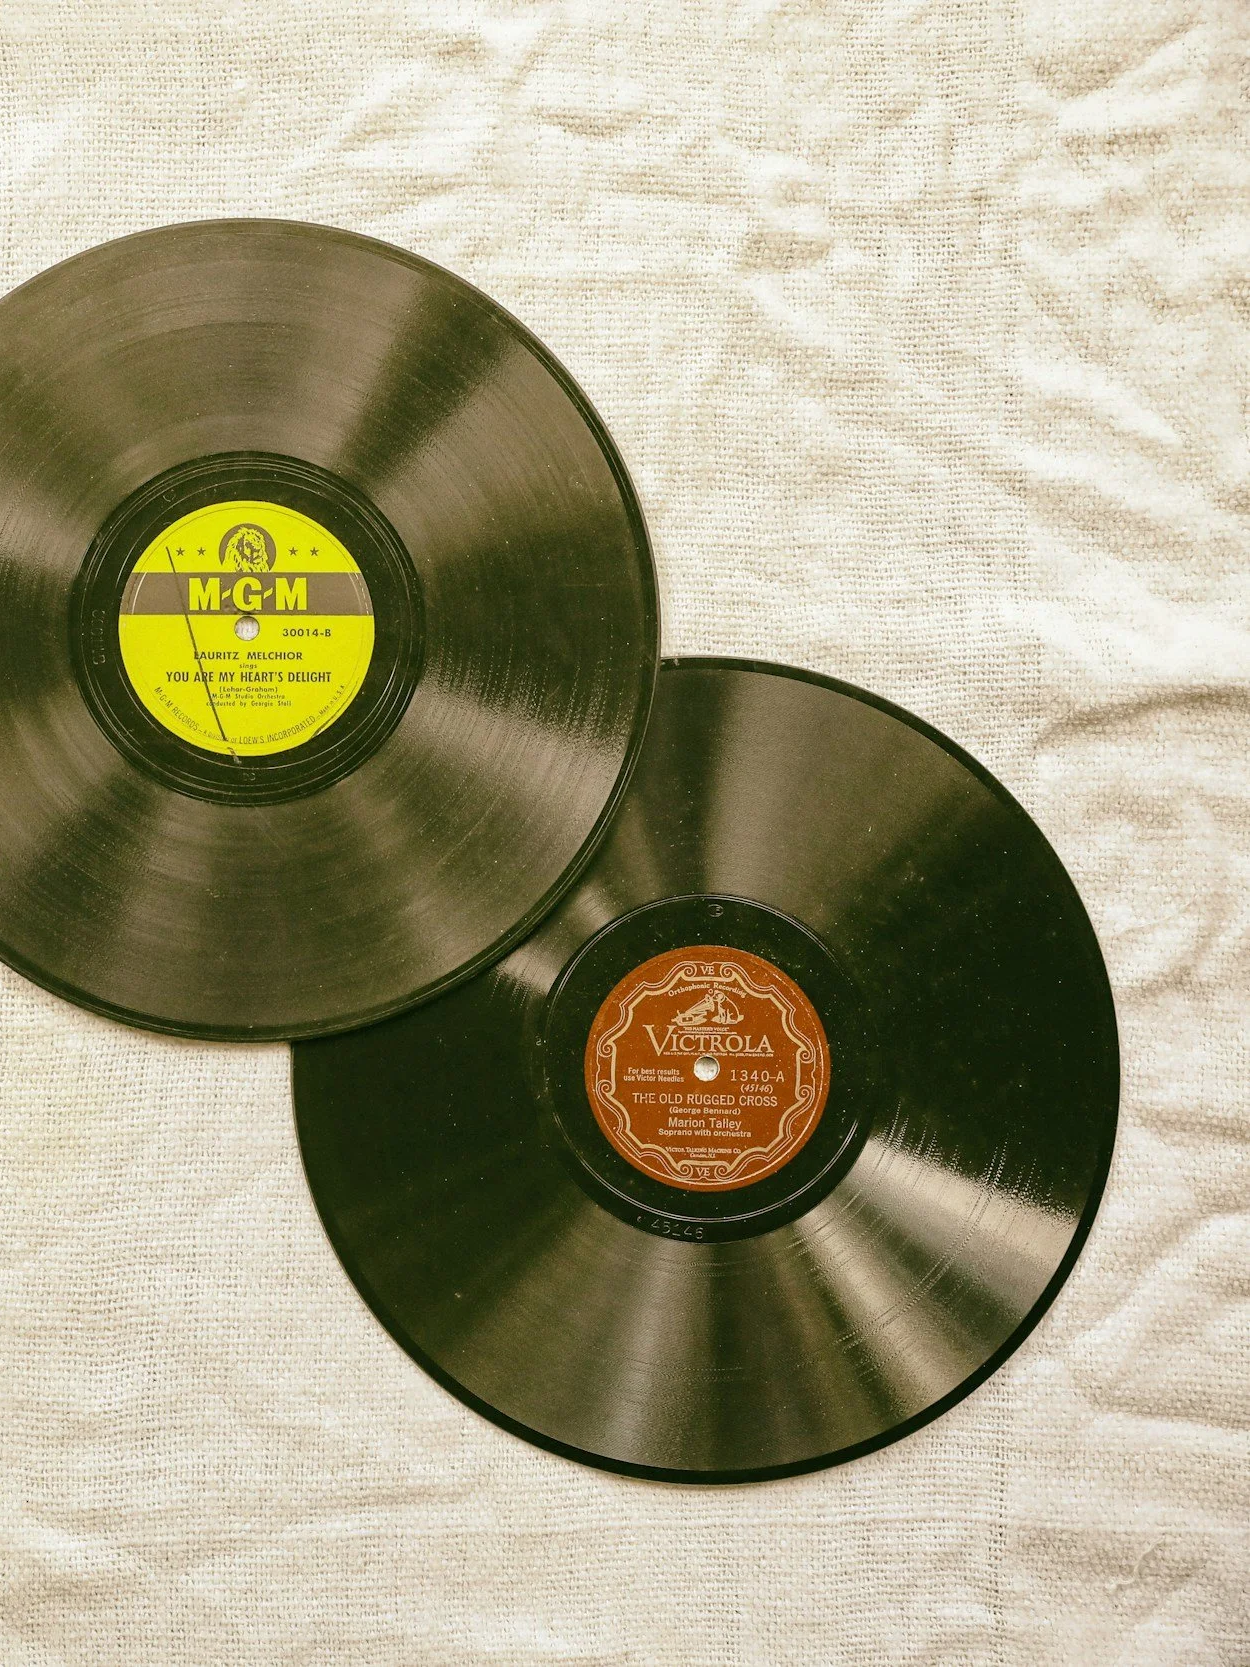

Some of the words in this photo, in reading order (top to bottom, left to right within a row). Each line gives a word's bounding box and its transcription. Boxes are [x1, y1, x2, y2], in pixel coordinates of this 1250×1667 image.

[282, 628, 332, 638] 30014-B
[193, 651, 240, 660] LAURITZ
[246, 651, 303, 660] MELCHIOR
[166, 671, 189, 682] YOU
[193, 671, 214, 682] ARE
[218, 671, 236, 682] MY
[240, 671, 284, 682] HEART'S
[287, 671, 332, 682] DELIGHT
[239, 700, 247, 708] by
[172, 706, 200, 731] RECORDS
[267, 715, 316, 742] INCORPORATED
[700, 966, 715, 975] VE
[668, 982, 710, 997] Orthophonic
[713, 982, 747, 999] Recording
[642, 1025, 774, 1057] VICTROLA
[628, 1067, 641, 1075] For
[641, 1067, 655, 1075] best
[656, 1068, 680, 1076] results
[657, 1075, 685, 1083] Needles
[740, 1083, 774, 1094] (45146)
[632, 1092, 656, 1104] THE
[659, 1093, 683, 1105] OLD
[686, 1093, 736, 1106] RUGGED
[738, 1095, 778, 1107] CROSS
[669, 1106, 701, 1115] (George
[703, 1107, 742, 1116] Bennard)
[668, 1117, 706, 1128] Marion
[709, 1118, 742, 1131] Talley
[658, 1128, 693, 1137] Soprano
[694, 1128, 712, 1137] with
[713, 1129, 752, 1138] orchestra
[695, 1167, 711, 1177] VE
